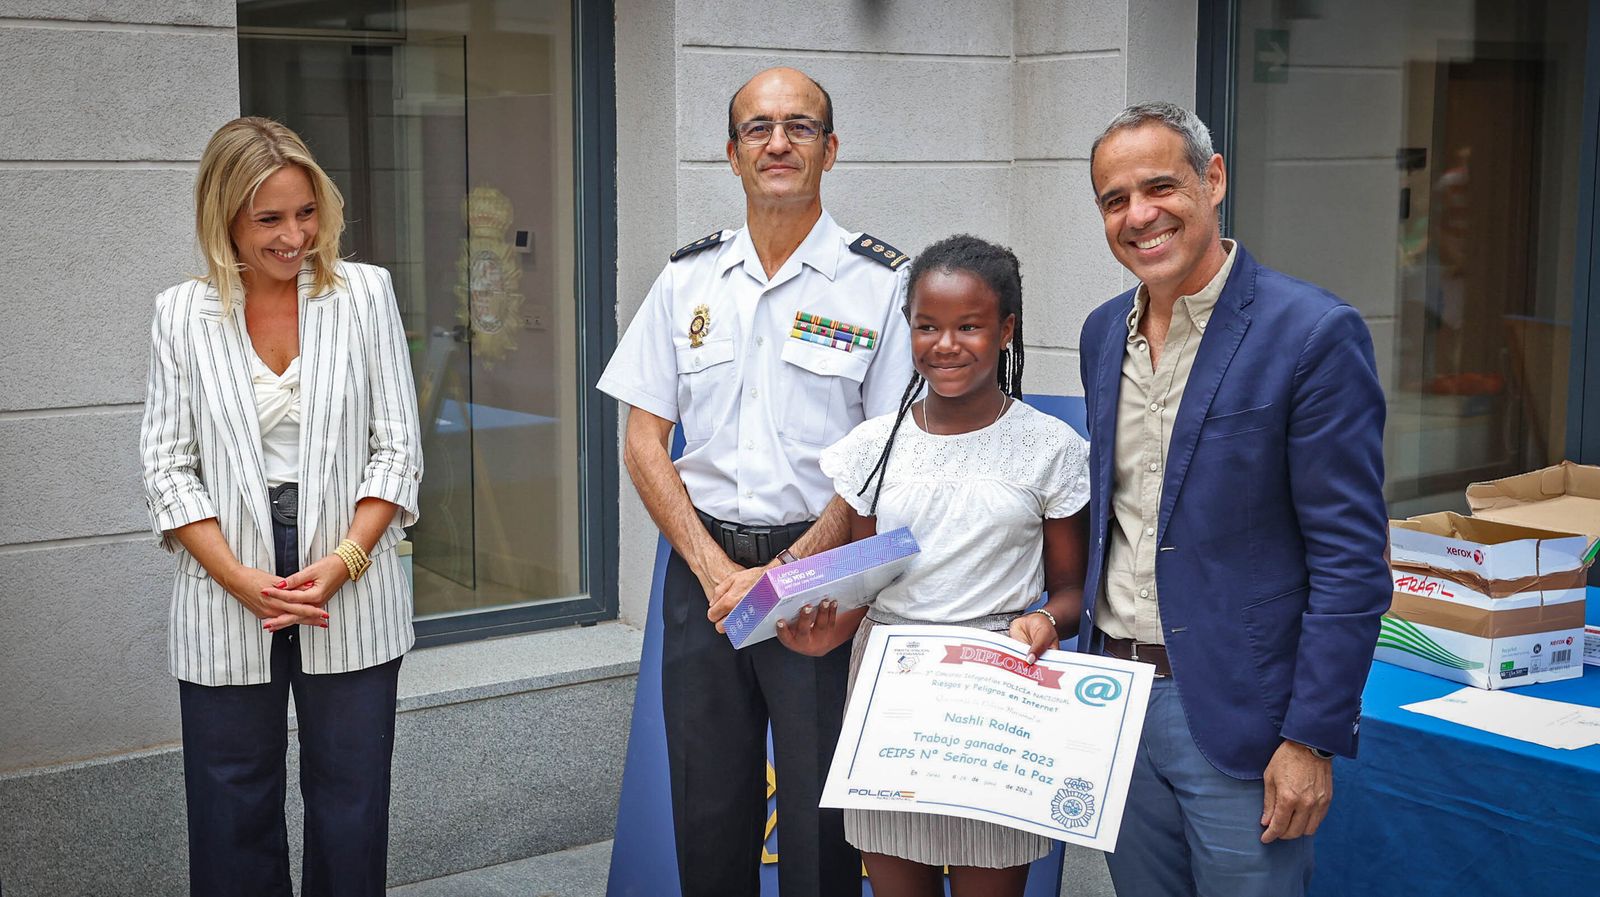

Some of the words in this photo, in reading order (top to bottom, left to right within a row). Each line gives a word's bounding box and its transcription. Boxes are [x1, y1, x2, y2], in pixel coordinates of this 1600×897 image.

[1446, 546, 1472, 558] xerox
[805, 569, 816, 577] HD
[960, 646, 1044, 681] DIPLOMA
[931, 680, 962, 690] Riesgos
[973, 683, 1006, 697] Peligros
[1009, 693, 1019, 701] en
[1022, 697, 1059, 713] Internet
[944, 712, 984, 727] Nashli
[989, 718, 1031, 739] Roldán
[913, 731, 961, 746] Trabajo
[965, 738, 1017, 756] ganador
[1021, 750, 1055, 768] 2023
[878, 747, 916, 759] CEIPS
[943, 751, 988, 767] Señora
[993, 760, 1009, 771] de
[1015, 764, 1026, 777] la
[1031, 769, 1054, 785] Paz
[1005, 783, 1013, 791] de
